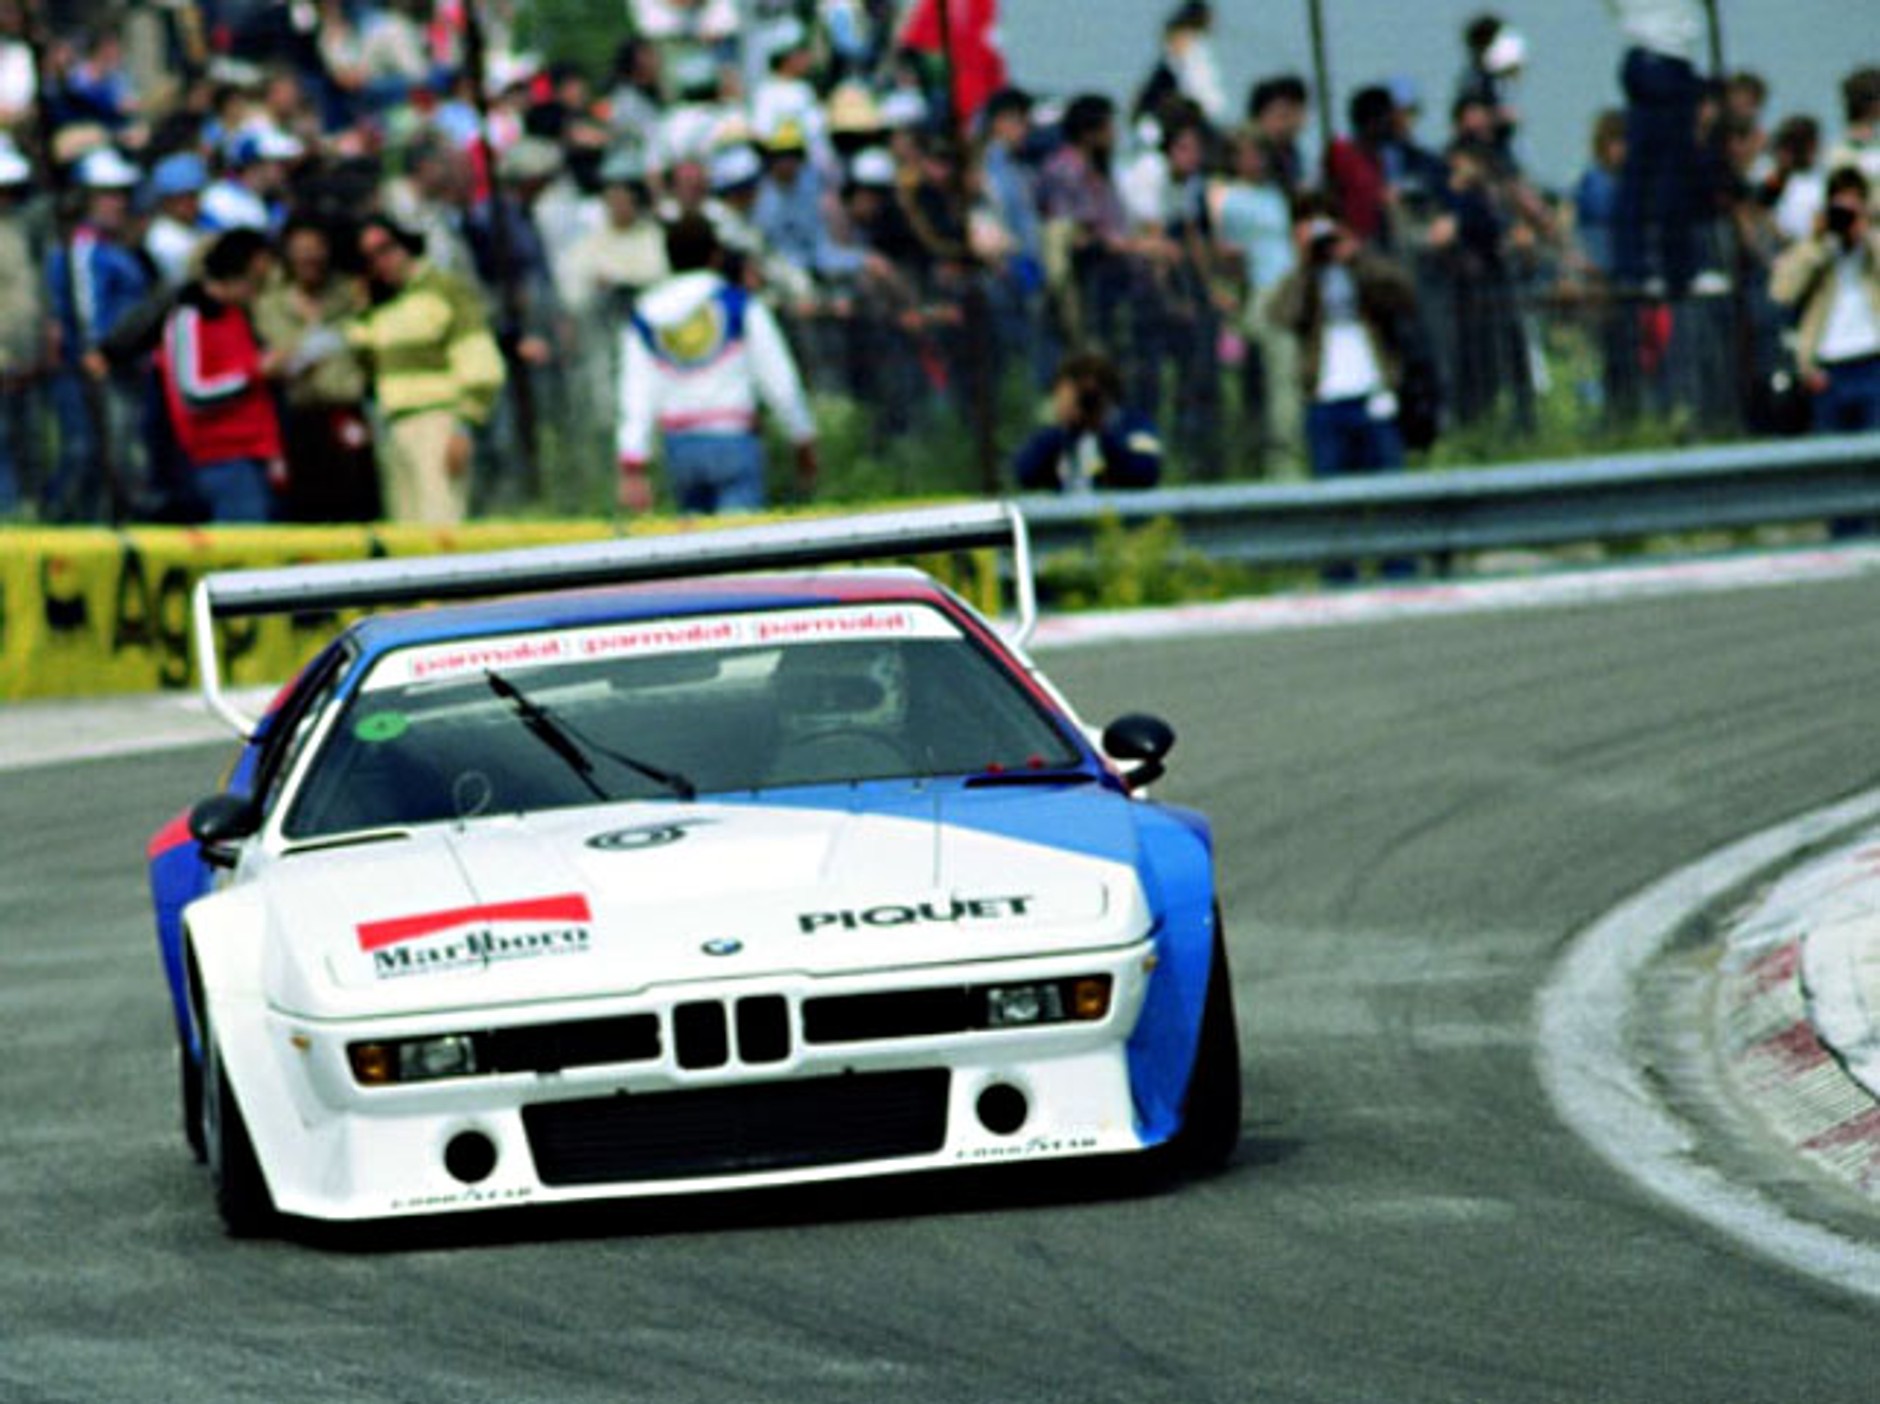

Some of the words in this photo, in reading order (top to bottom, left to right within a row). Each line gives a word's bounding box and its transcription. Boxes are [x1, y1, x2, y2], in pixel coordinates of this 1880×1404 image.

[413, 639, 561, 676] parmalat
[584, 624, 732, 654] parmalat
[759, 612, 905, 640] parmalat
[798, 893, 1034, 934] PIQUET
[373, 928, 590, 970] Marlboro
